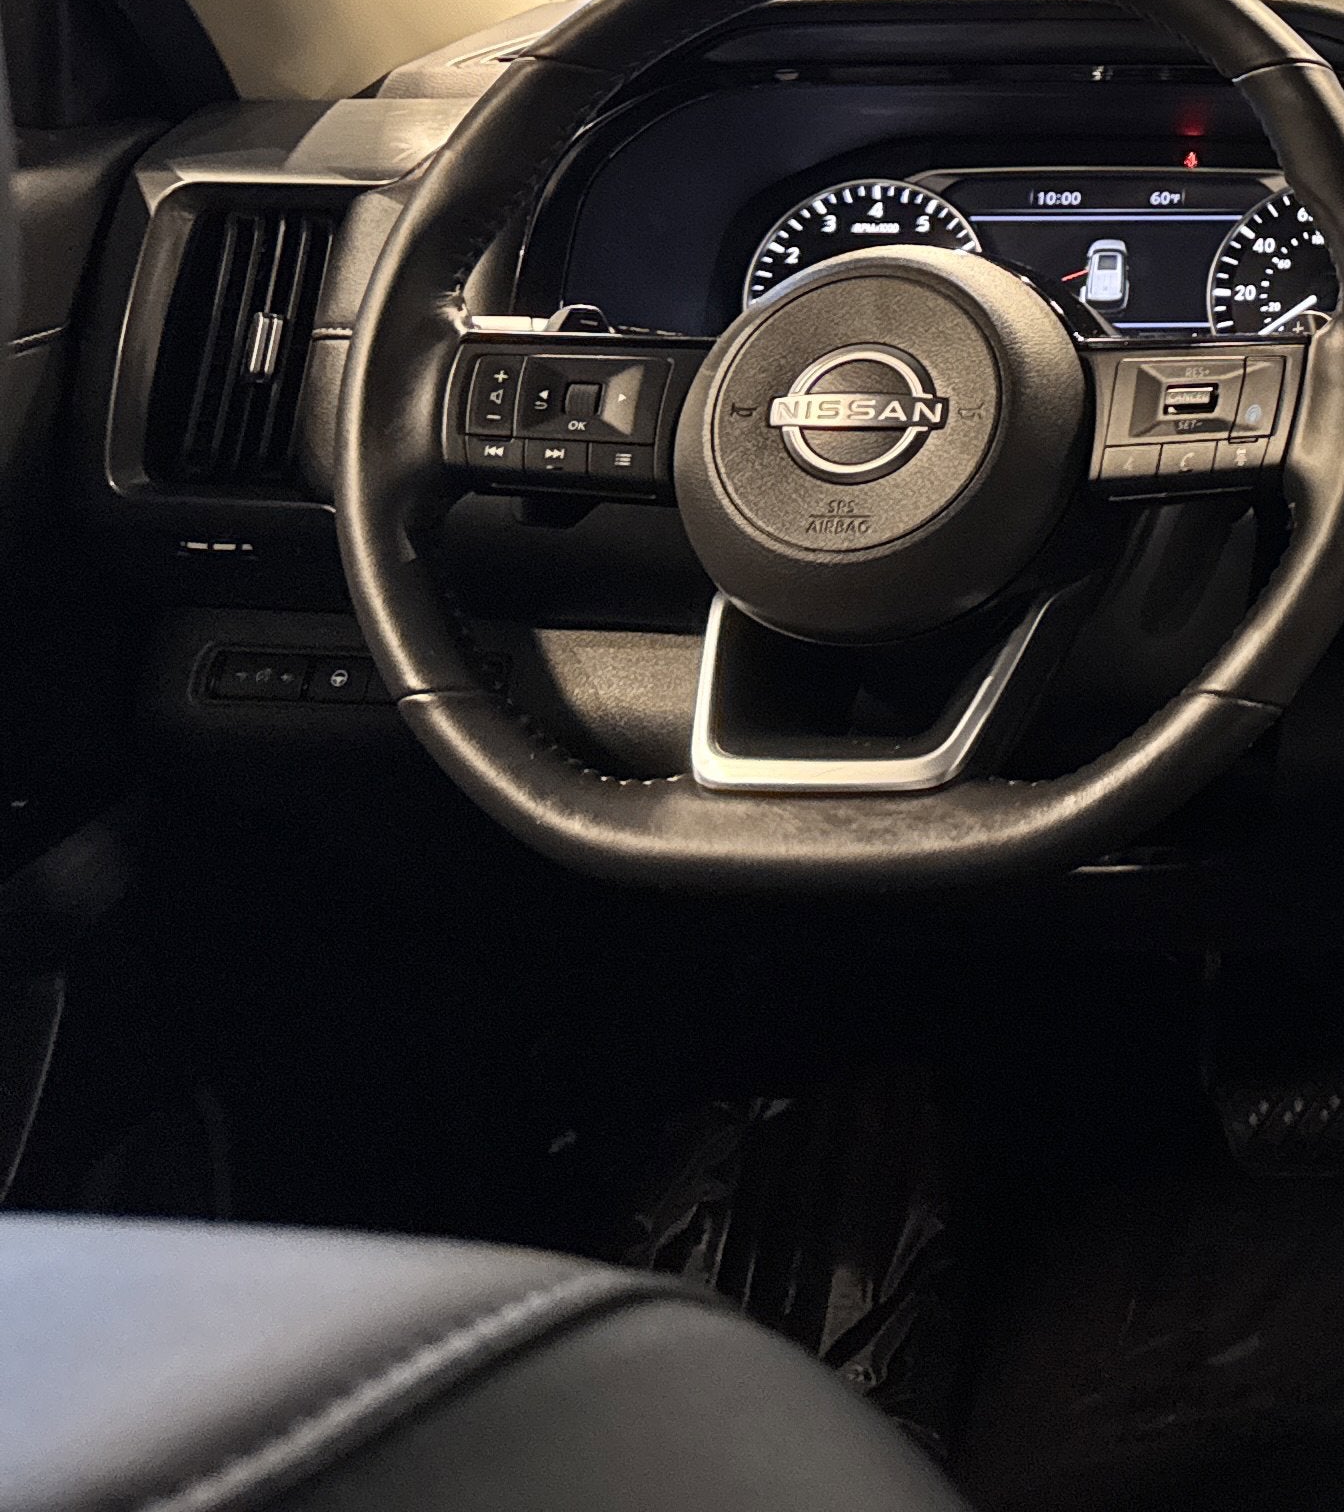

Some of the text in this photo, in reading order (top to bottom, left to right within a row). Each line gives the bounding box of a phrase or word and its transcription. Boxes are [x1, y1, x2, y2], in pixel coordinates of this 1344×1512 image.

[1037, 191, 1082, 206] 10:00
[867, 201, 884, 219] 4
[1297, 207, 1314, 222] 6
[821, 214, 838, 233] 3
[915, 215, 931, 233] 5
[1252, 238, 1276, 254] 40
[785, 247, 801, 265] 2
[1234, 285, 1257, 301] 20
[1167, 391, 1210, 404] CANCEL
[776, 399, 943, 423] NISSAN
[567, 420, 588, 431] OK
[805, 520, 871, 535] AIRBAG
